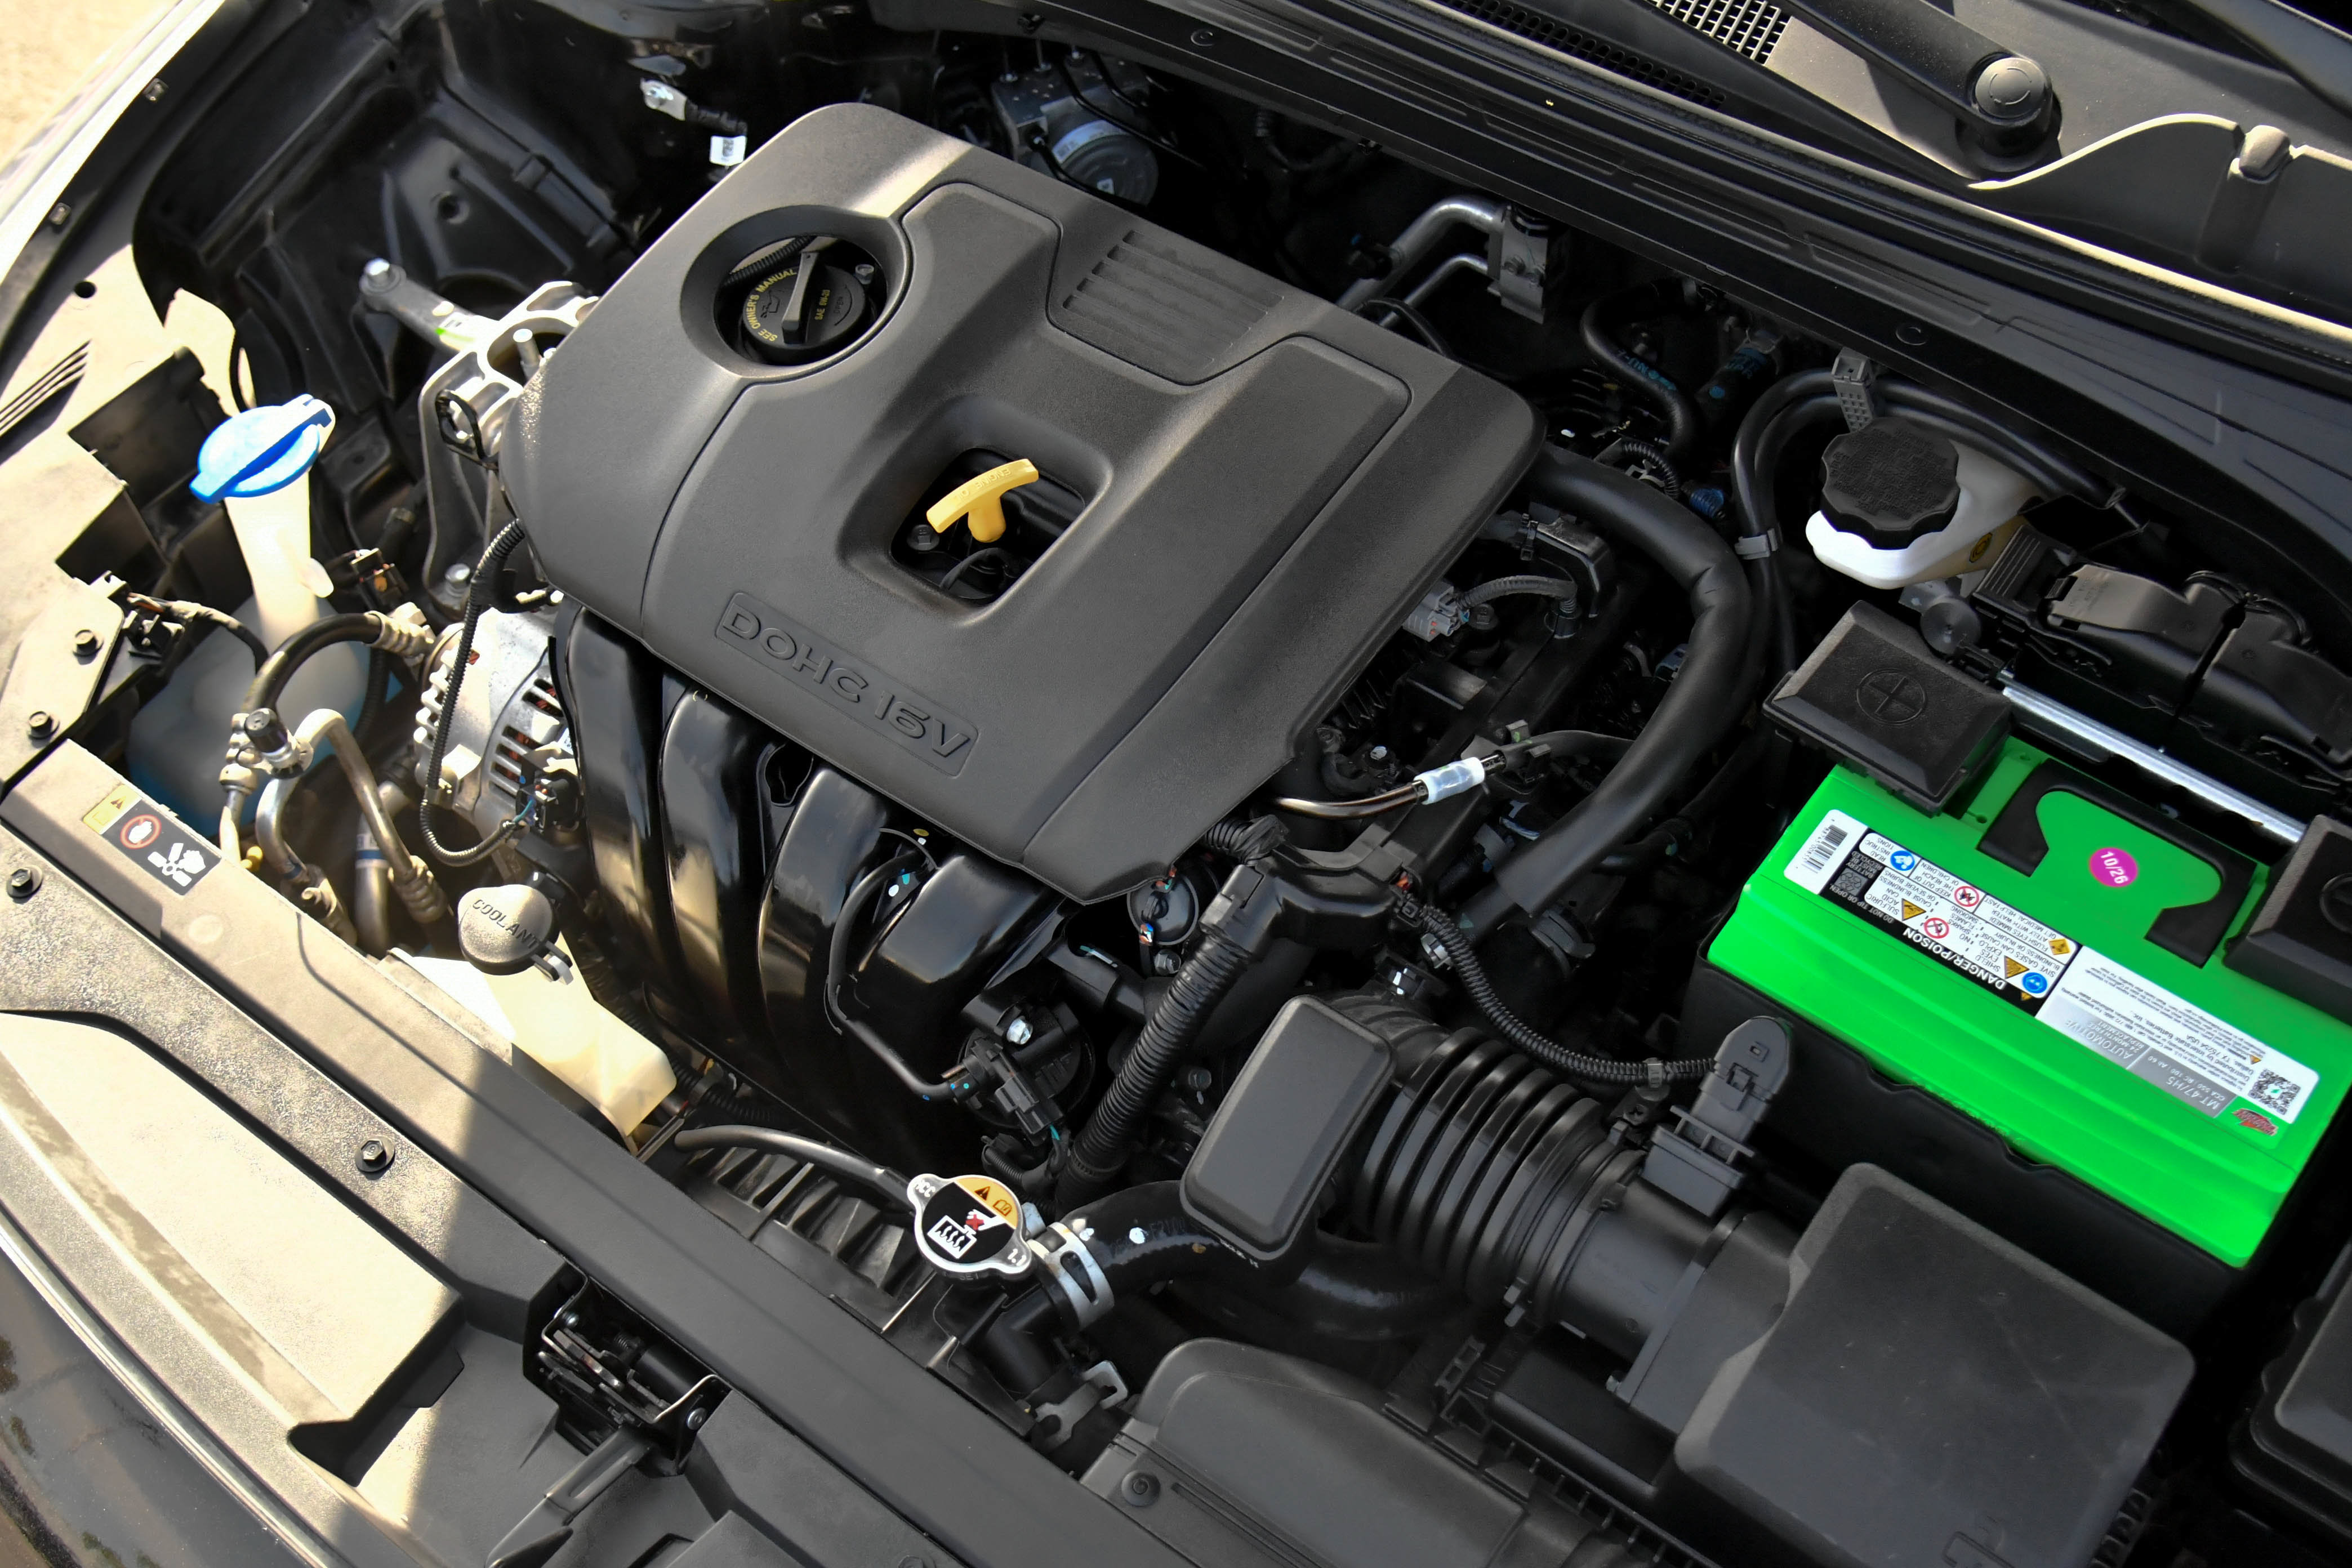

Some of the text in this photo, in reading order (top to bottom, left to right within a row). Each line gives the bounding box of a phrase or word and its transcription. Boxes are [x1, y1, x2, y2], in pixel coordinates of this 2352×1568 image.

[746, 269, 797, 342] SEE OWNER'S MANUAL
[814, 308, 825, 320] SAE
[975, 468, 1012, 489] ENGINE
[723, 603, 970, 758] DOHC 16V
[1876, 837, 1895, 850] TIONS
[1849, 856, 1877, 874] MUST BE
[1851, 850, 1883, 870] RECYCLED
[1869, 850, 1886, 862] READ
[1845, 860, 1874, 879] BATTERY
[1920, 862, 1950, 881] CHILDREN
[2101, 851, 2128, 884] 10/26
[1904, 881, 1927, 896] SEVERE
[1921, 871, 1955, 892] THE REACH
[1921, 879, 1935, 889] OUT
[1878, 875, 1932, 907] CAUSE BLINDNESS
[1881, 893, 1899, 906] ACID
[1885, 887, 1900, 898] CAN
[1926, 893, 1936, 901] OR
[1934, 885, 1951, 898] KEEP
[1827, 883, 1894, 923] DO NOT TIP OR OPEN.
[1865, 893, 1900, 915] SULFURIC
[1999, 905, 2016, 917] HELP
[473, 899, 540, 948] COOLANT
[1949, 905, 1979, 924] SMOKING
[1949, 912, 1975, 929] FLAMES
[2017, 915, 2044, 932] MEDICAL
[1946, 918, 1971, 935] SPARKS
[1990, 908, 2048, 943] ATELY WITH WATER
[2011, 928, 2028, 941] EYES
[2043, 929, 2057, 939] GET
[1958, 933, 1971, 943] NO
[2028, 937, 2049, 952] FLUSH
[1902, 926, 2007, 991] DANGER/POISON
[1979, 932, 2056, 978] SIVE GASES CAN CAUSE
[1979, 948, 1999, 963] EYES
[1993, 930, 2061, 971] BLINDNESS OR INJURY
[1974, 954, 2001, 972] SHIELD
[2087, 1021, 2104, 1034] FREE
[2096, 1019, 2144, 1049] REPLACEMENT
[2063, 1018, 2133, 1062] AUTOMOTIVE
[2103, 1030, 2139, 1053] 24-MONTH
[2165, 1075, 2221, 1111] MT-47/H5
[1008, 1249, 1027, 1267] 1.1
